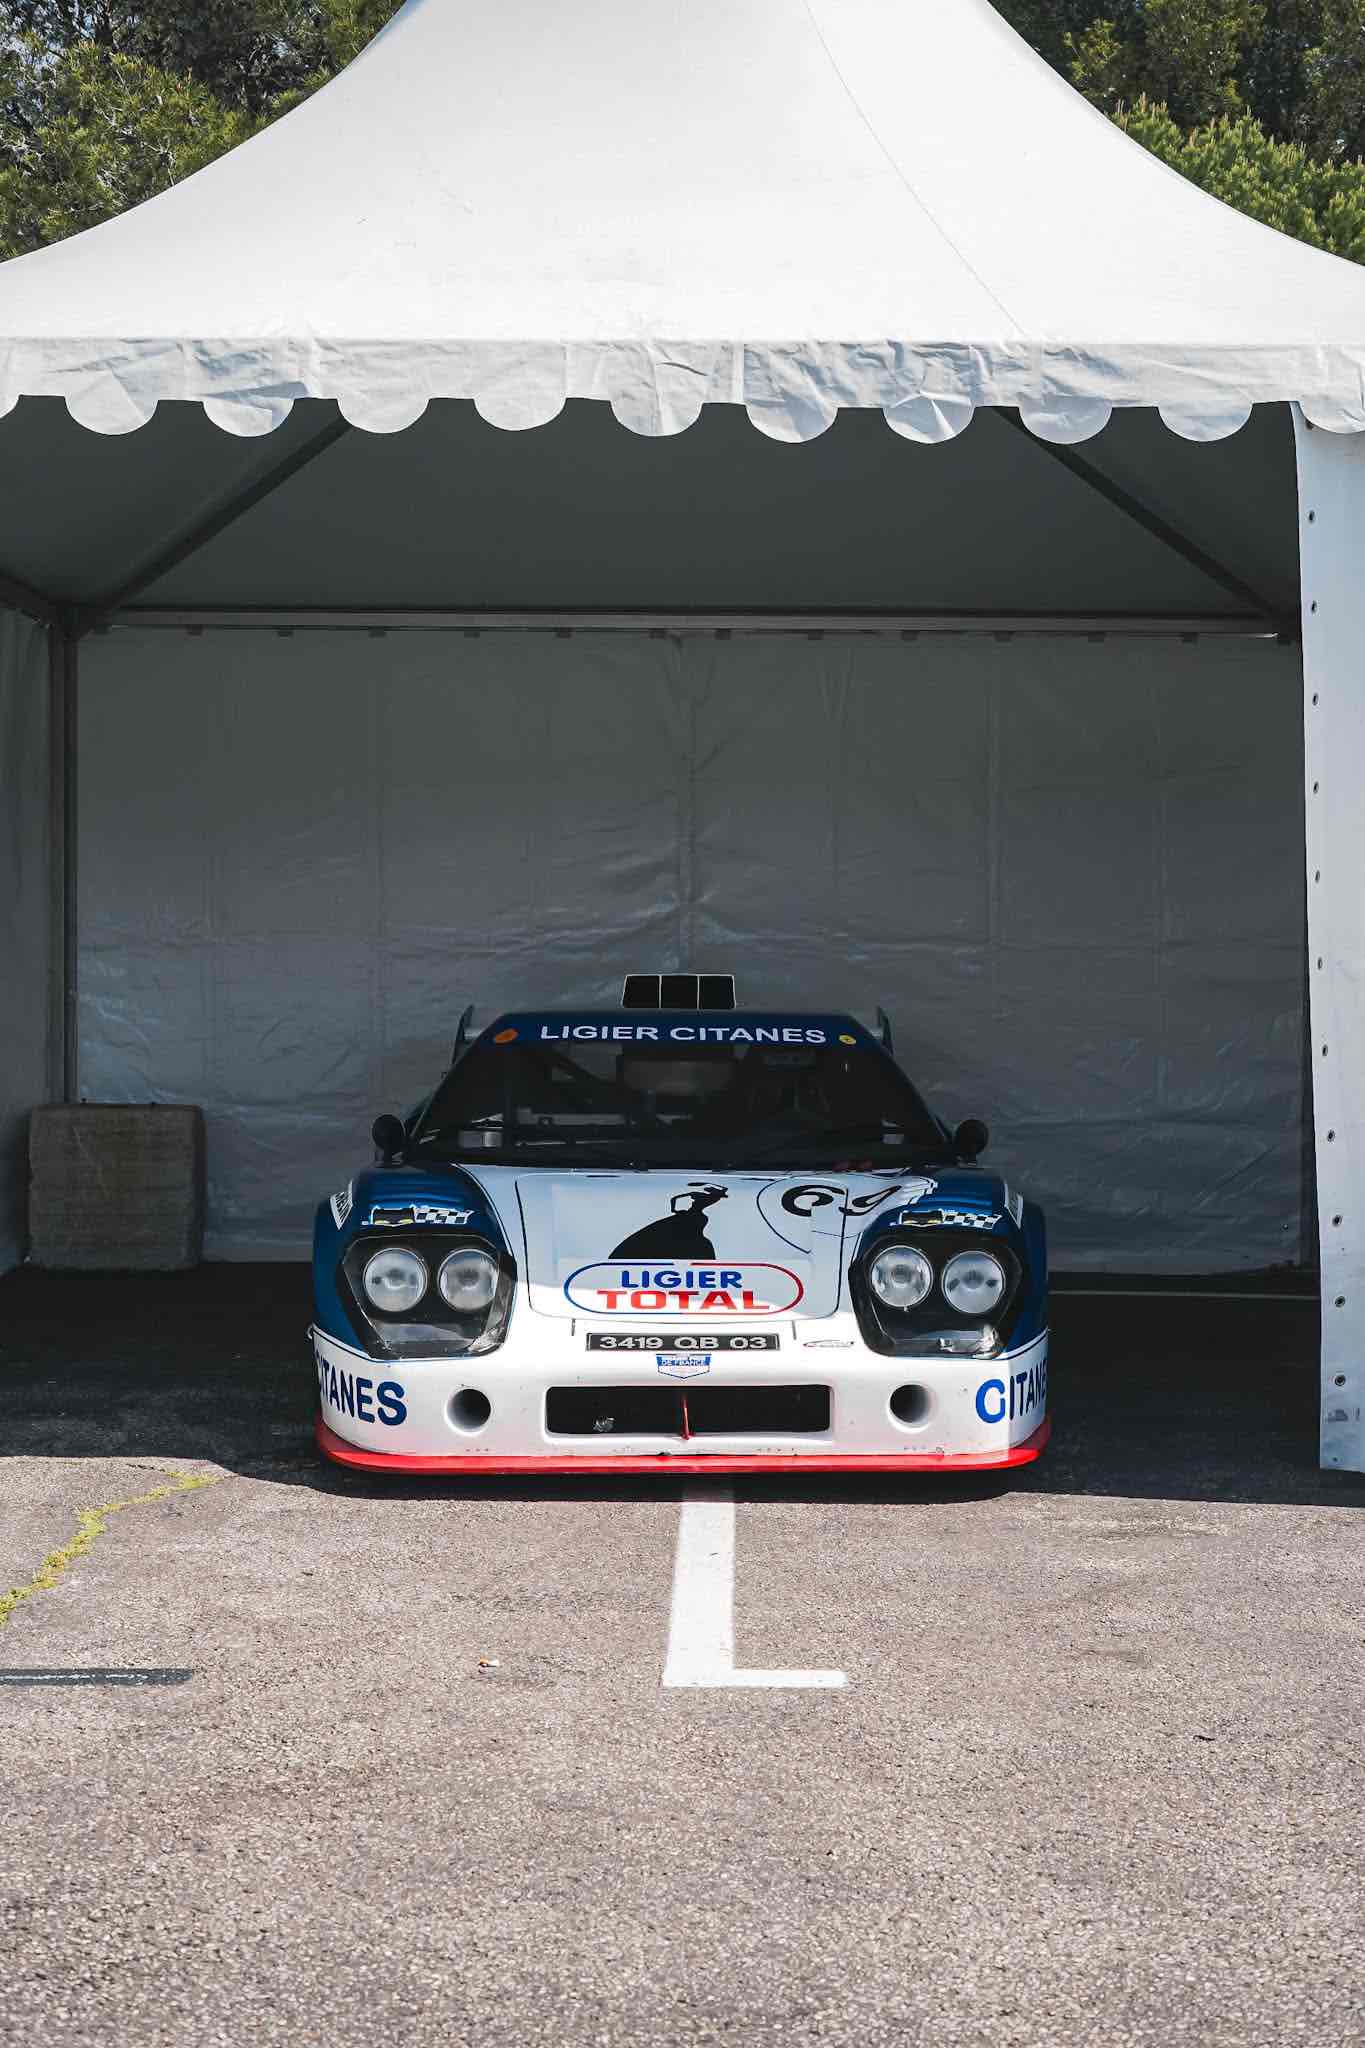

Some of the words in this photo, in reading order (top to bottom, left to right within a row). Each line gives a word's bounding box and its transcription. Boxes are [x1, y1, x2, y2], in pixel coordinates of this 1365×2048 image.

[540, 1025, 659, 1041] LIGIER
[621, 1270, 742, 1289] LIGIER
[596, 1290, 770, 1311] TOTAL
[599, 1336, 664, 1350] 3419
[674, 1336, 720, 1350] QB
[729, 1336, 768, 1350] 03
